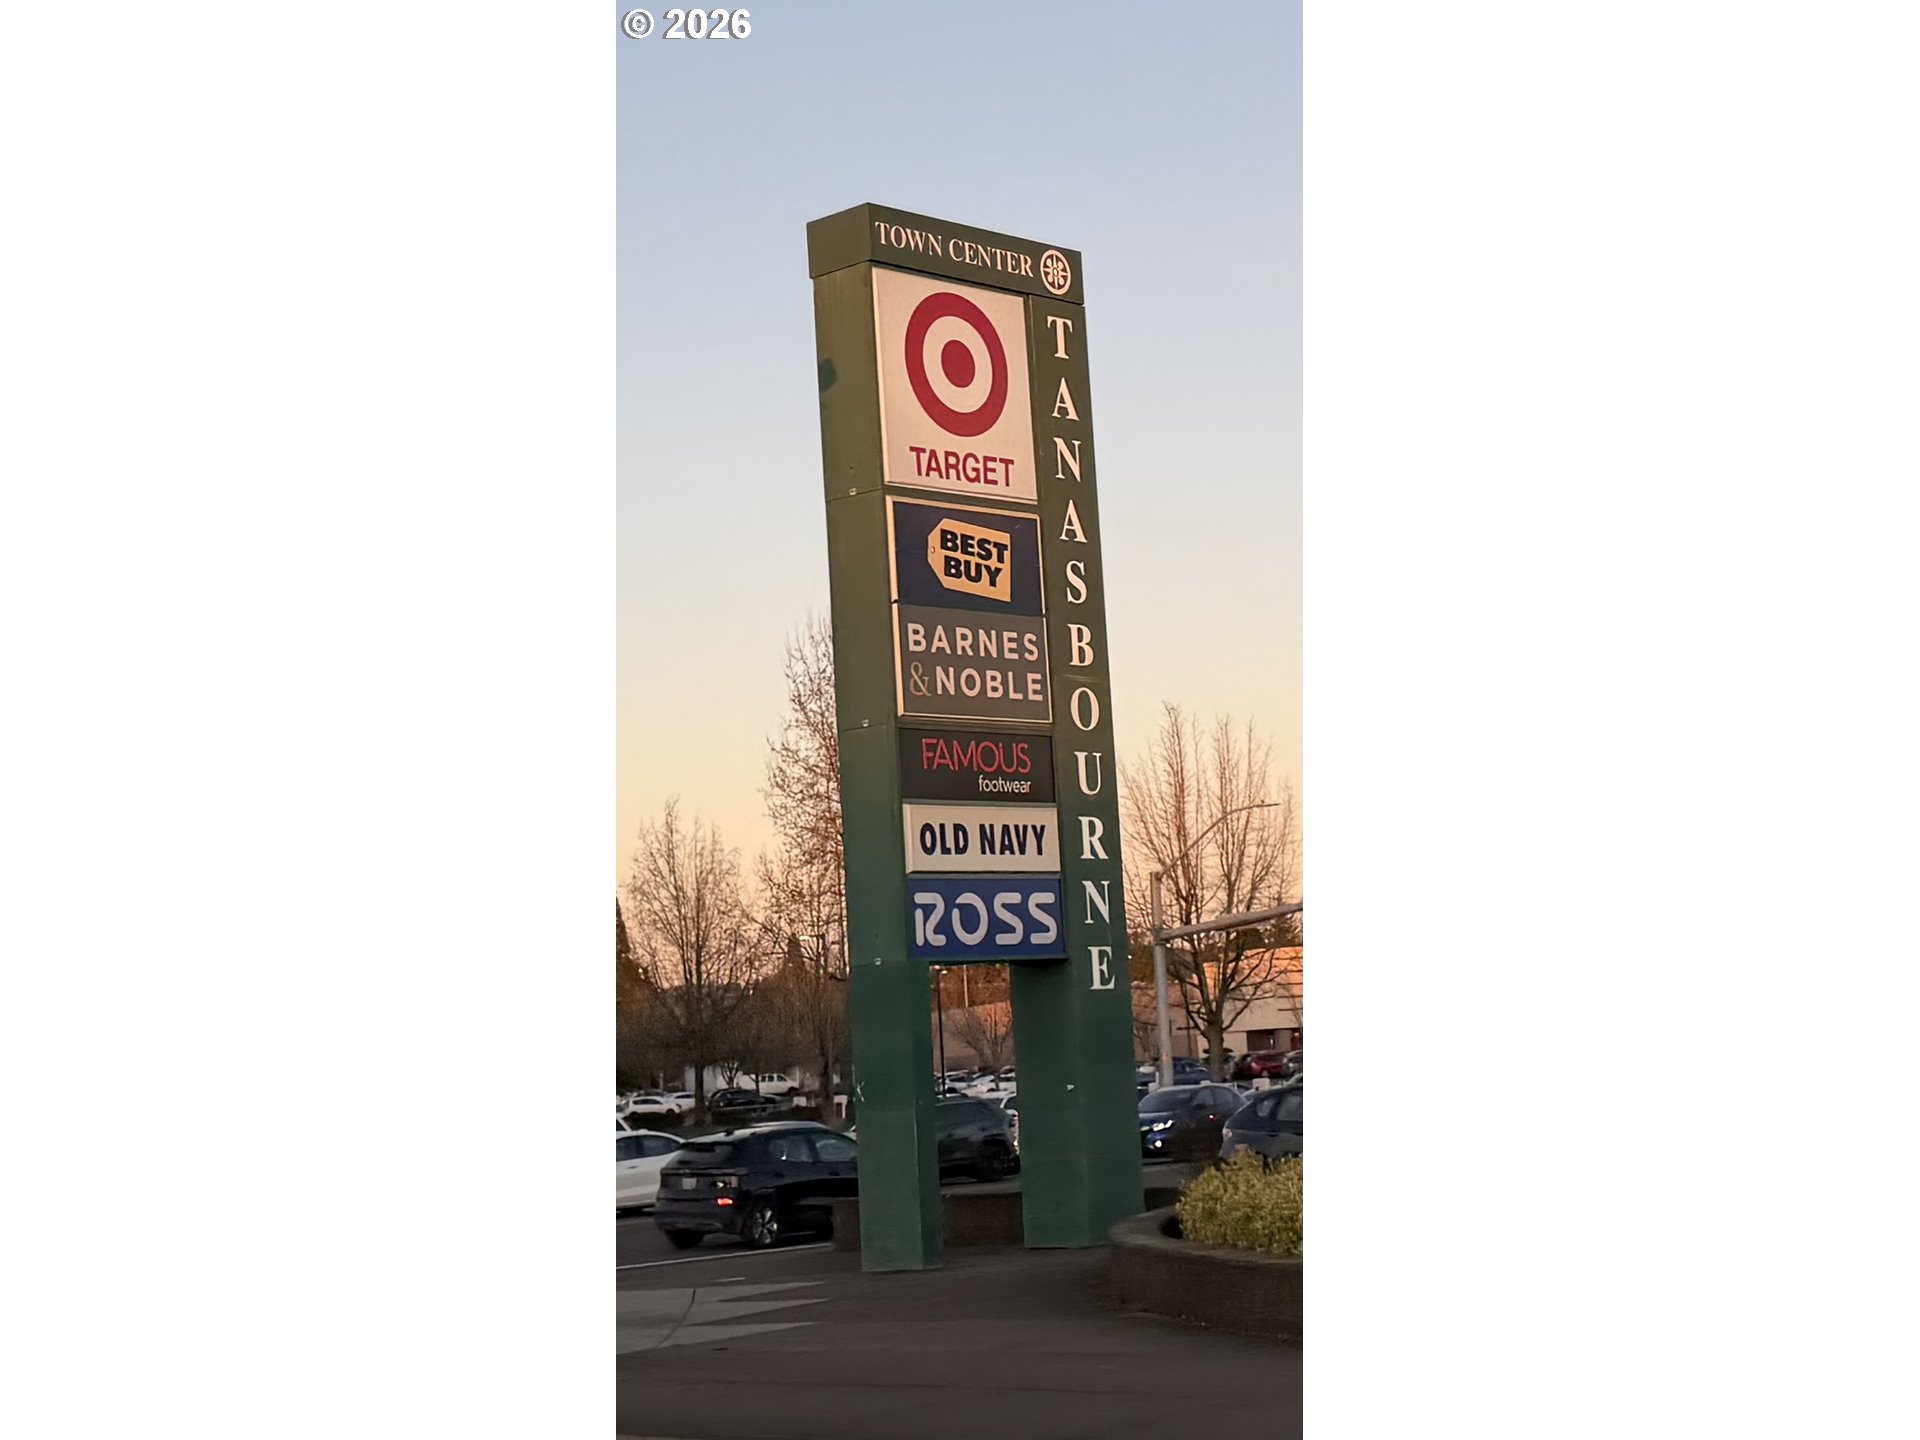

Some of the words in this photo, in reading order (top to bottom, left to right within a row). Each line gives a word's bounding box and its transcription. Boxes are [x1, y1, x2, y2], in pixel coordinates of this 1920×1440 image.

[875, 220, 943, 257] TOWN
[949, 238, 1034, 278] CENTER
[909, 445, 1015, 487] TARGET
[939, 528, 1009, 564] BEST
[943, 555, 1003, 588] BUY
[907, 622, 1039, 662] BARNES
[1047, 314, 1115, 991] TANASBOURNE
[921, 738, 1033, 774] FAMOUS
[978, 774, 1032, 794] footwear
[919, 822, 970, 856] OLD
[979, 823, 1047, 856] NAVY
[914, 892, 1058, 947] ROSS
